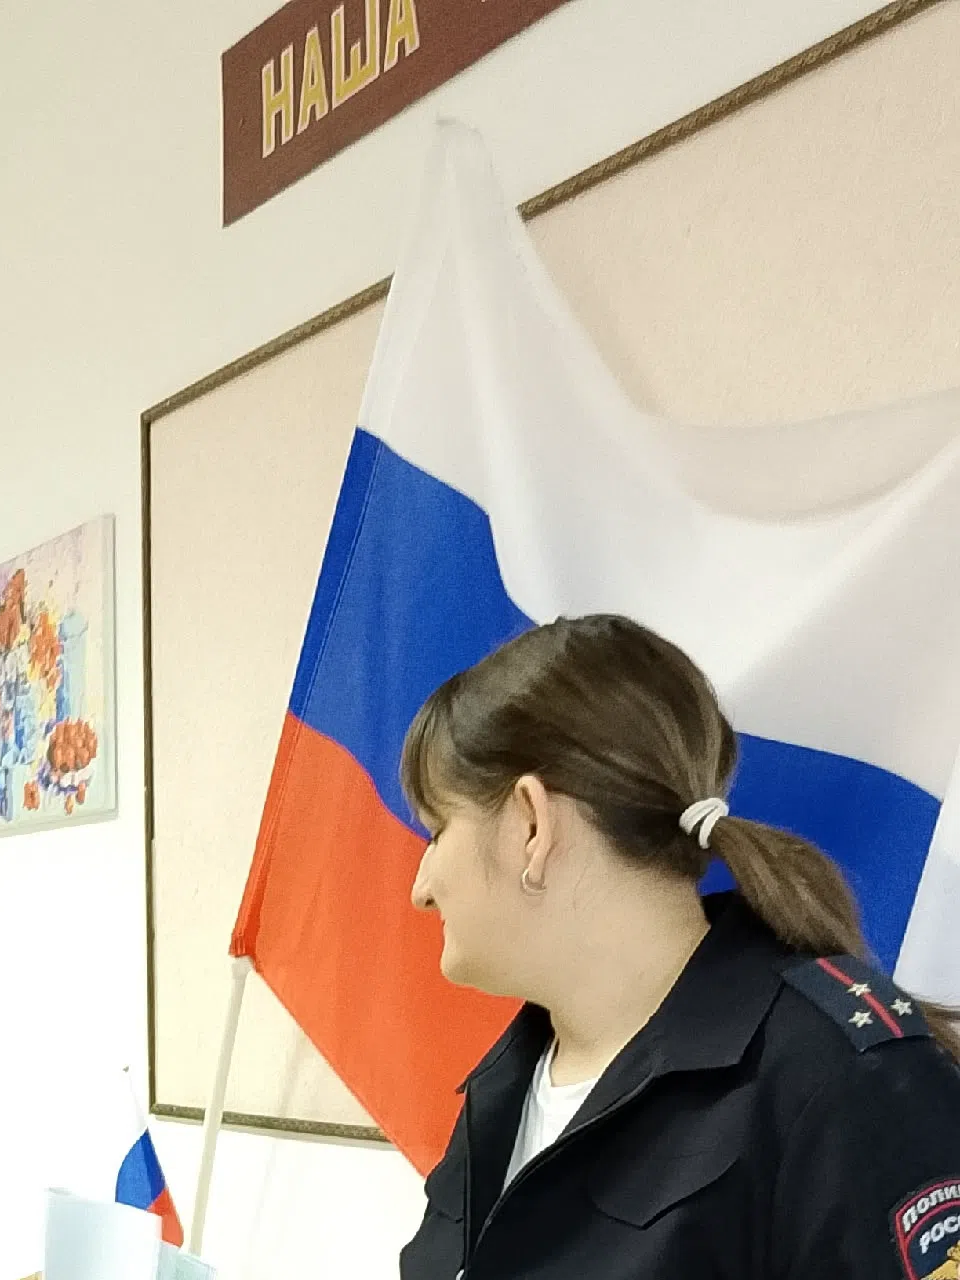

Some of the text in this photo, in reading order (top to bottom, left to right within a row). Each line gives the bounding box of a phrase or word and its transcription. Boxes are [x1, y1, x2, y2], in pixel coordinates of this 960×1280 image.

[260, 0, 421, 159] НАША
[902, 1184, 960, 1233] ПОЛИ
[919, 1214, 960, 1254] РОС
